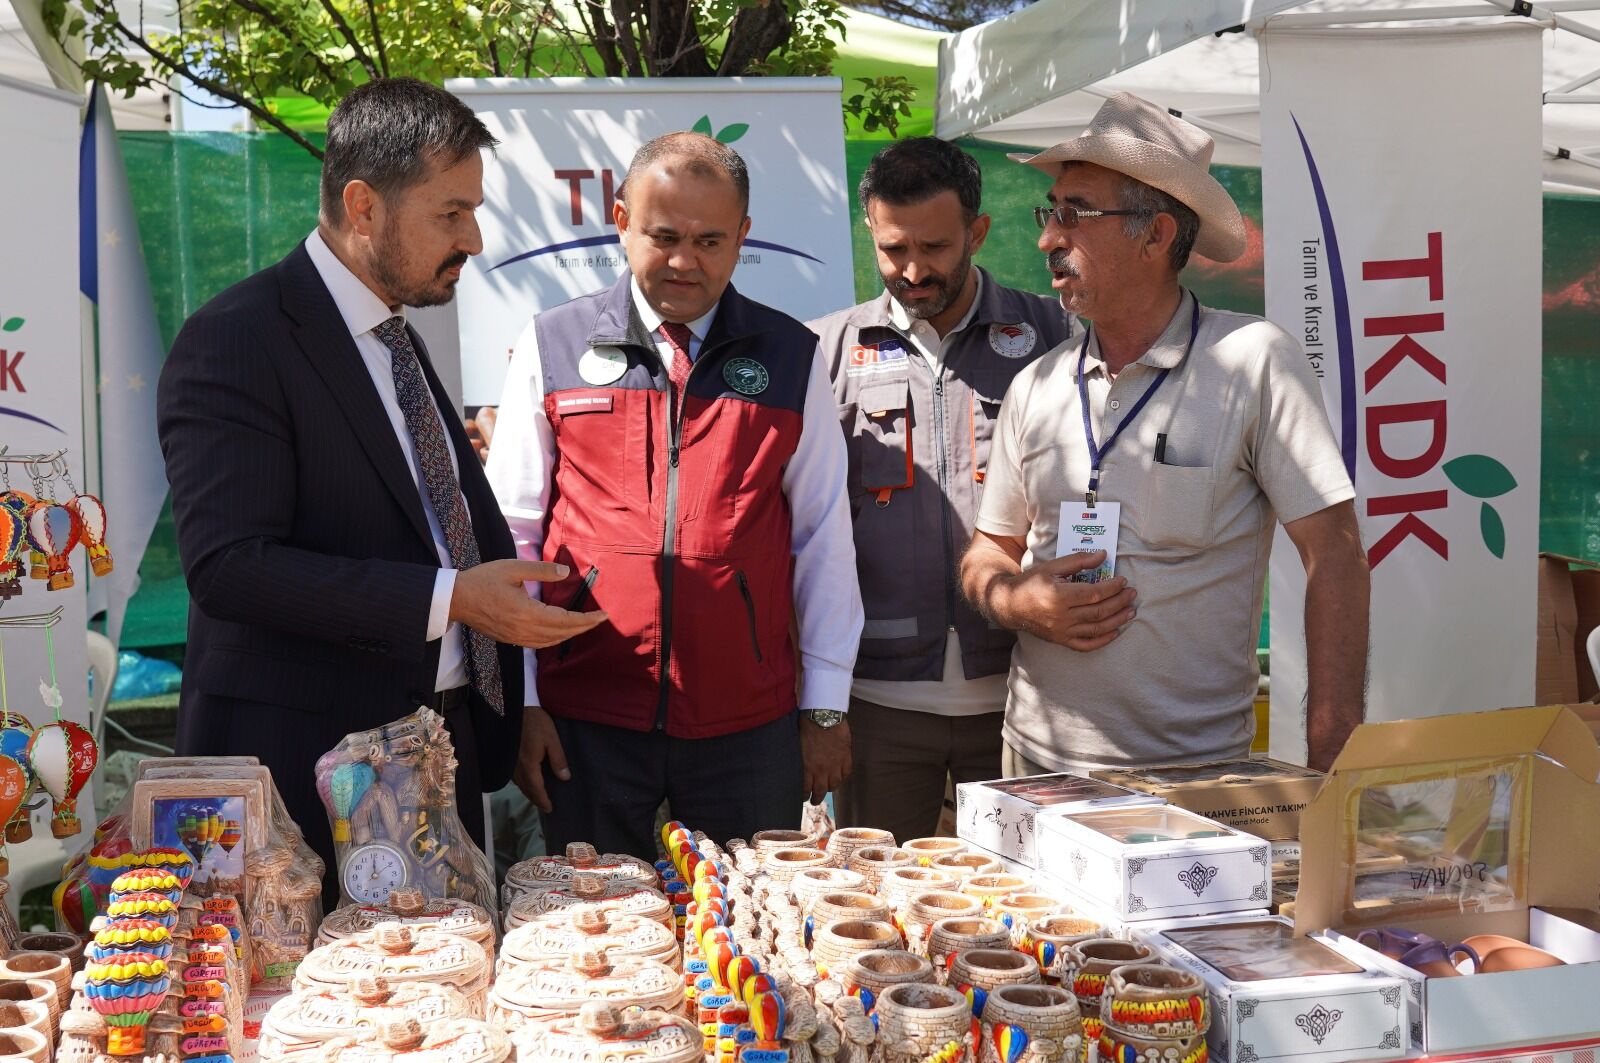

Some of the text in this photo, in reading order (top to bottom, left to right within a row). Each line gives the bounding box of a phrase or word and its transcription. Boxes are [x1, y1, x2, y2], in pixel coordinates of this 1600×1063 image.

[554, 255, 580, 268] Tarım
[583, 258, 593, 267] ve
[596, 254, 621, 268] Kırsal
[1302, 237, 1320, 279] Tarım
[1304, 284, 1318, 301] ve
[1305, 306, 1324, 347] Kırsal
[1362, 232, 1448, 572] TKDK
[1203, 808, 1237, 819] KAHVE
[1240, 806, 1274, 816] FİNCAN
[1229, 819, 1249, 827] Hand
